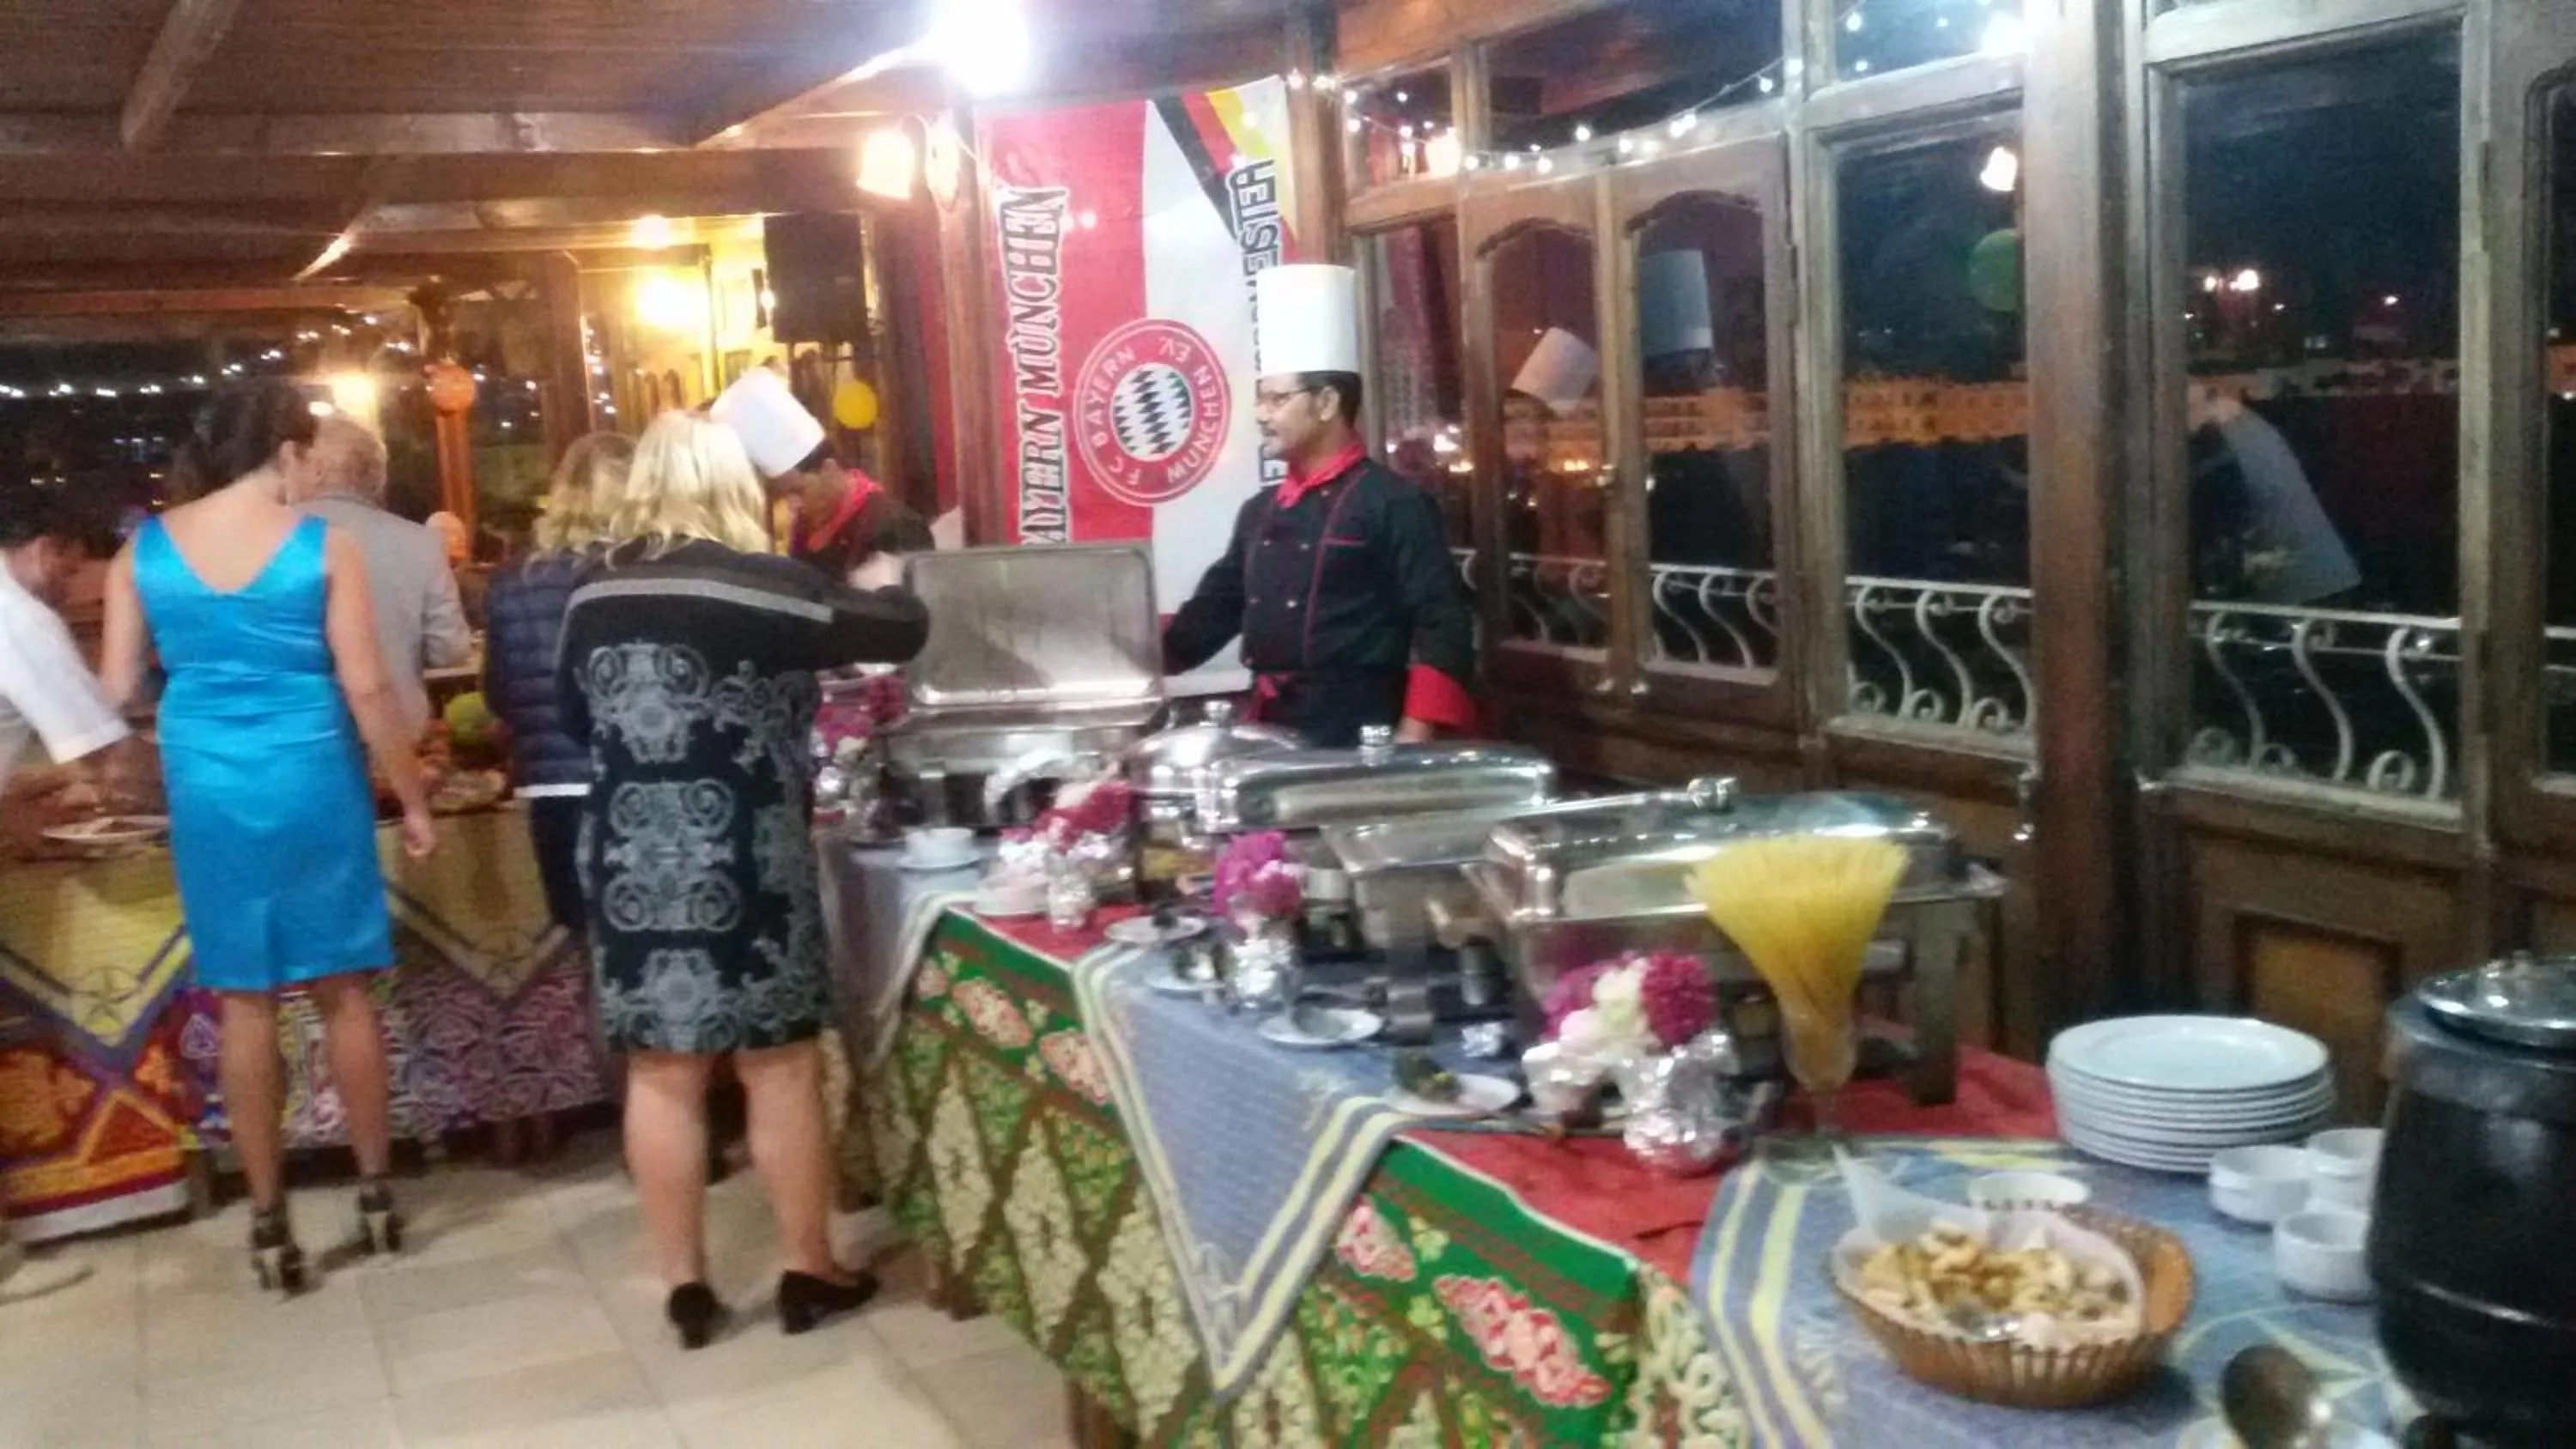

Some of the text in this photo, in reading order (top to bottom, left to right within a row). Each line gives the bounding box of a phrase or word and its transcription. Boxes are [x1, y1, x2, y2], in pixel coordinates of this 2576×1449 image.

[1085, 346, 1136, 447] BAYERN
[1019, 401, 1068, 544] AYERN
[1109, 457, 1142, 486] FC
